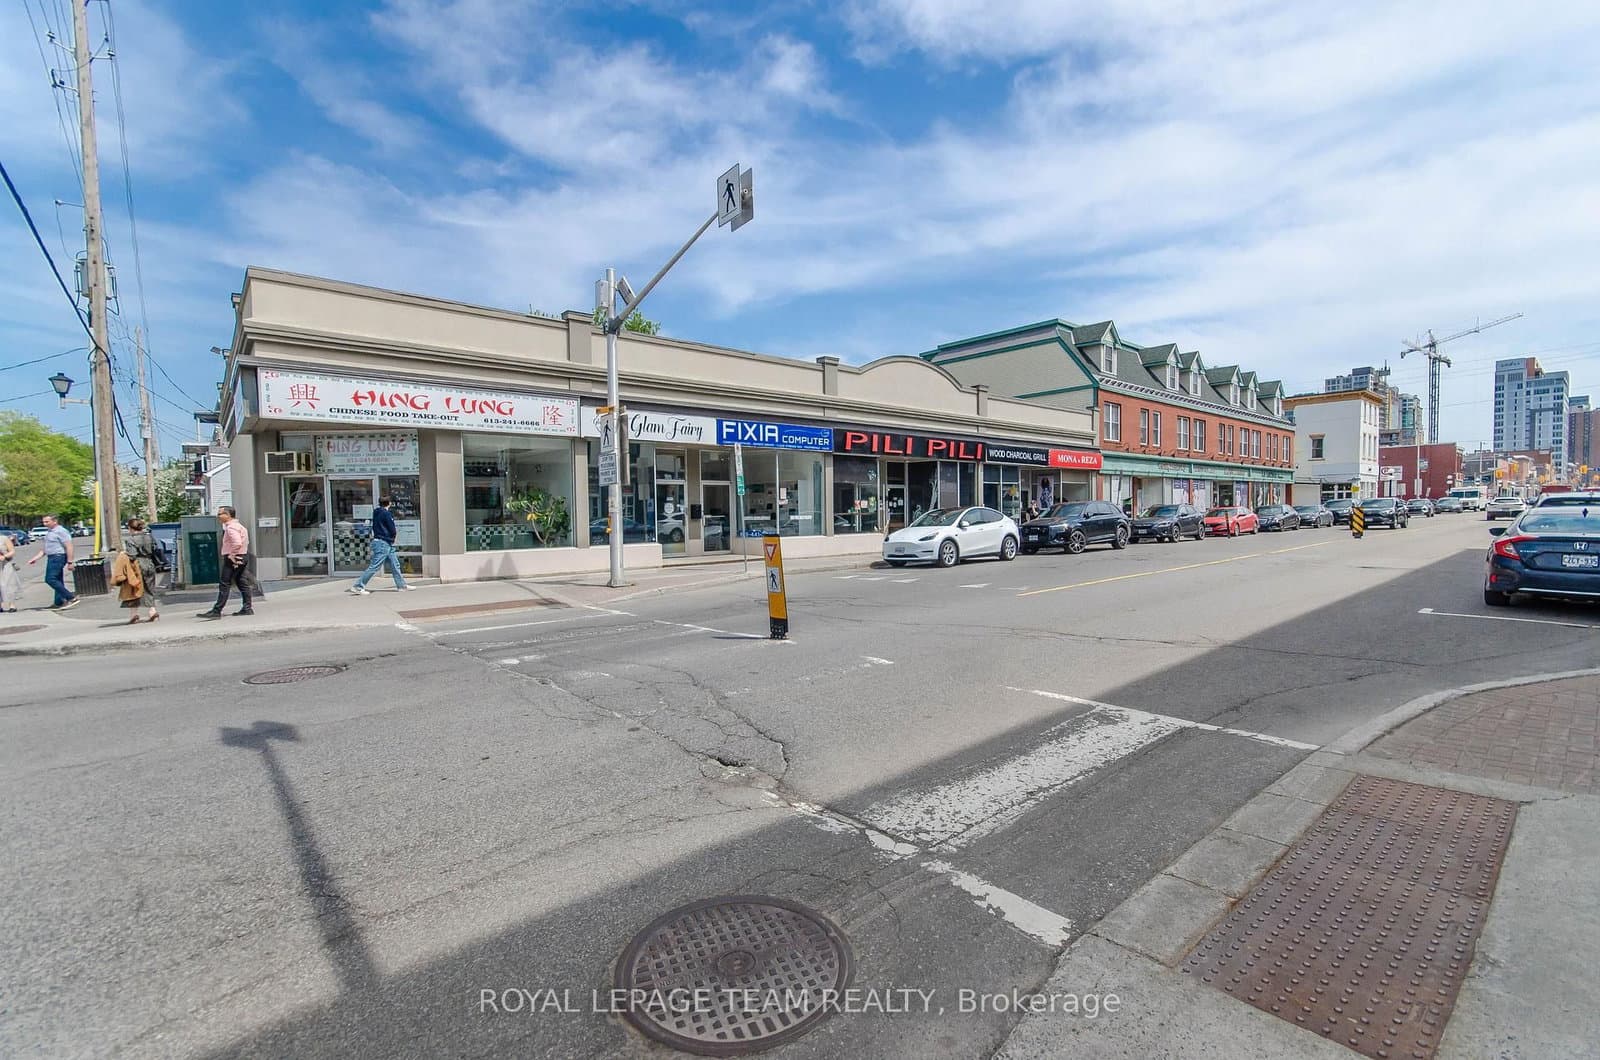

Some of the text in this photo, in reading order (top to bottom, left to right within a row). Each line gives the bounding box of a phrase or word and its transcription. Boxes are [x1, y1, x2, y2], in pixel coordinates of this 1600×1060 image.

[287, 383, 321, 409] 興
[351, 389, 514, 417] HING LUNG
[329, 407, 460, 422] CHINESE FOOD TAKE-OUT
[483, 418, 540, 427] 613-241-6666
[542, 404, 565, 426] 隆
[630, 413, 665, 438] Glam
[665, 416, 703, 442] Fairy
[722, 421, 779, 443] FIXIA
[782, 435, 830, 446] COMPUTER
[844, 431, 983, 460] PILI PILI
[989, 449, 1047, 462] WOOD CHARCOAL GRILL
[1057, 454, 1078, 464] MONA
[1081, 455, 1098, 465] REZA
